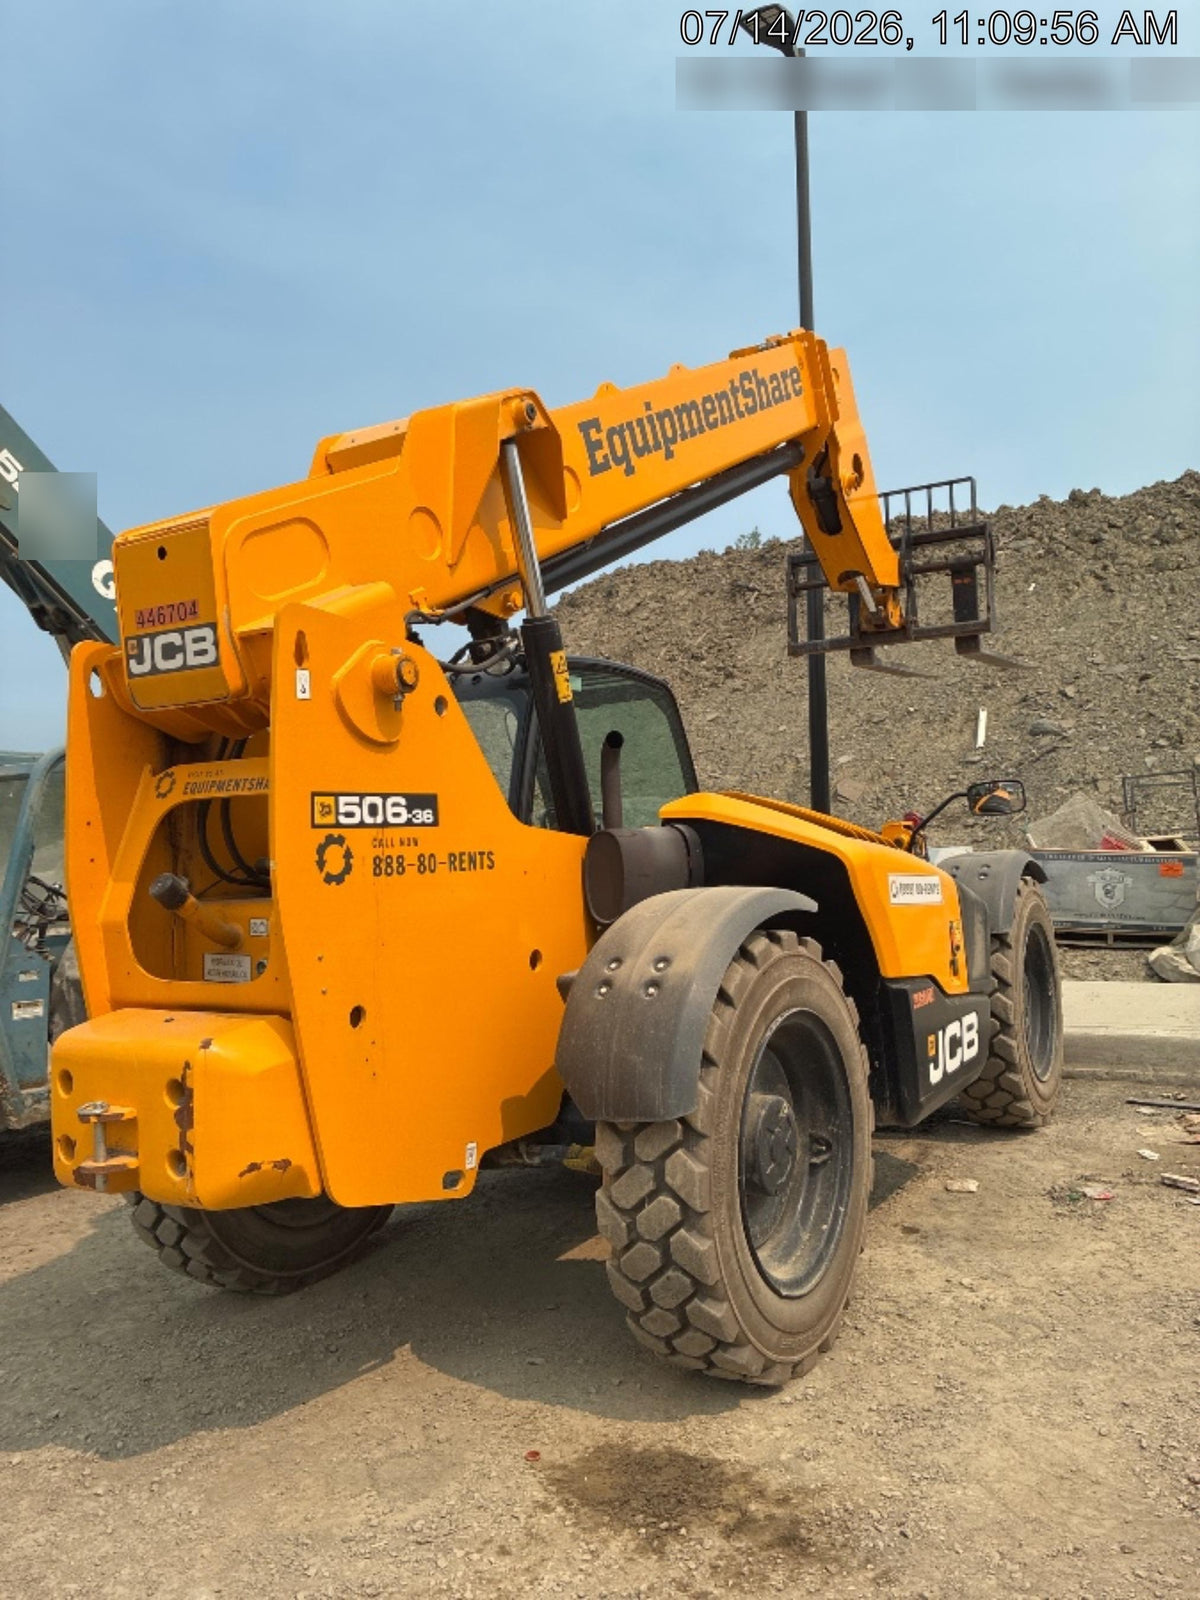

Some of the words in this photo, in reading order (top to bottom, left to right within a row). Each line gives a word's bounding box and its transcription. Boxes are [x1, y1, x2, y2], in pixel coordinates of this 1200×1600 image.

[577, 365, 803, 478] EquipmentShare
[136, 600, 198, 628] 446704
[128, 627, 217, 675] JCB
[372, 850, 495, 878] 888-80-RENTS
[929, 1010, 979, 1085] JCB
